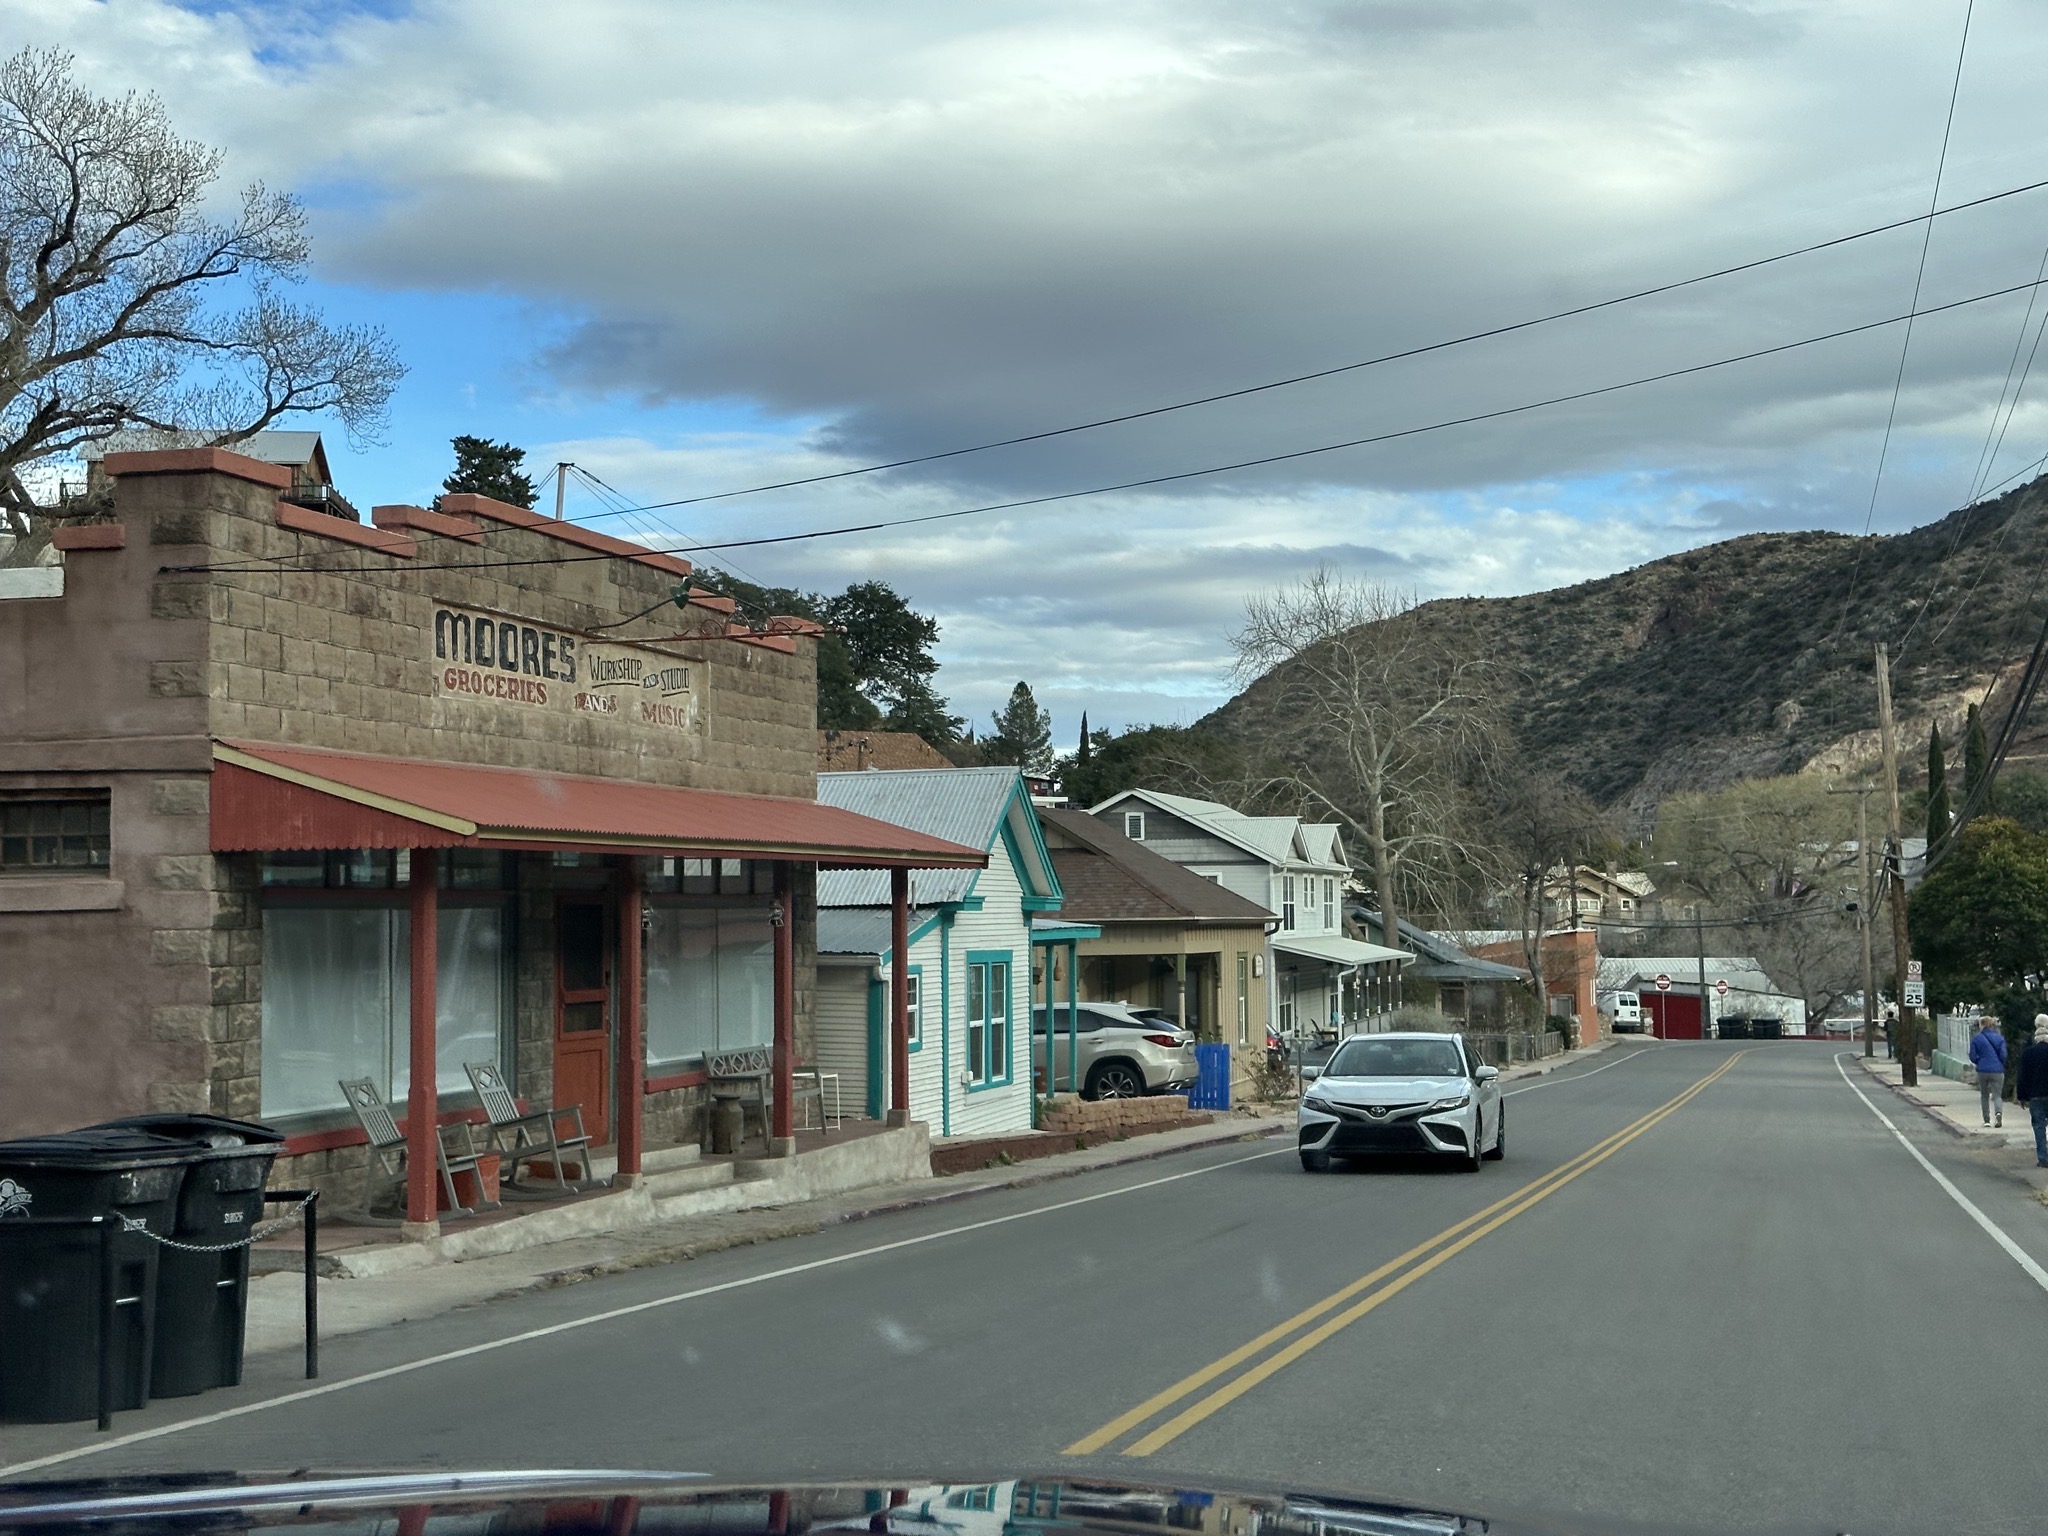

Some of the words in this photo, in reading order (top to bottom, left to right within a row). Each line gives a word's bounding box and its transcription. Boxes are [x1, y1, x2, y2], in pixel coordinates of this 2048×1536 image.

[435, 609, 577, 683] MOORE'S
[588, 654, 642, 681] WORKSHOP
[660, 667, 690, 691] STUDIO
[444, 668, 547, 705] GROCERIES
[583, 694, 608, 714] AND
[641, 701, 686, 728] MUSIC
[1906, 994, 1922, 1004] 25
